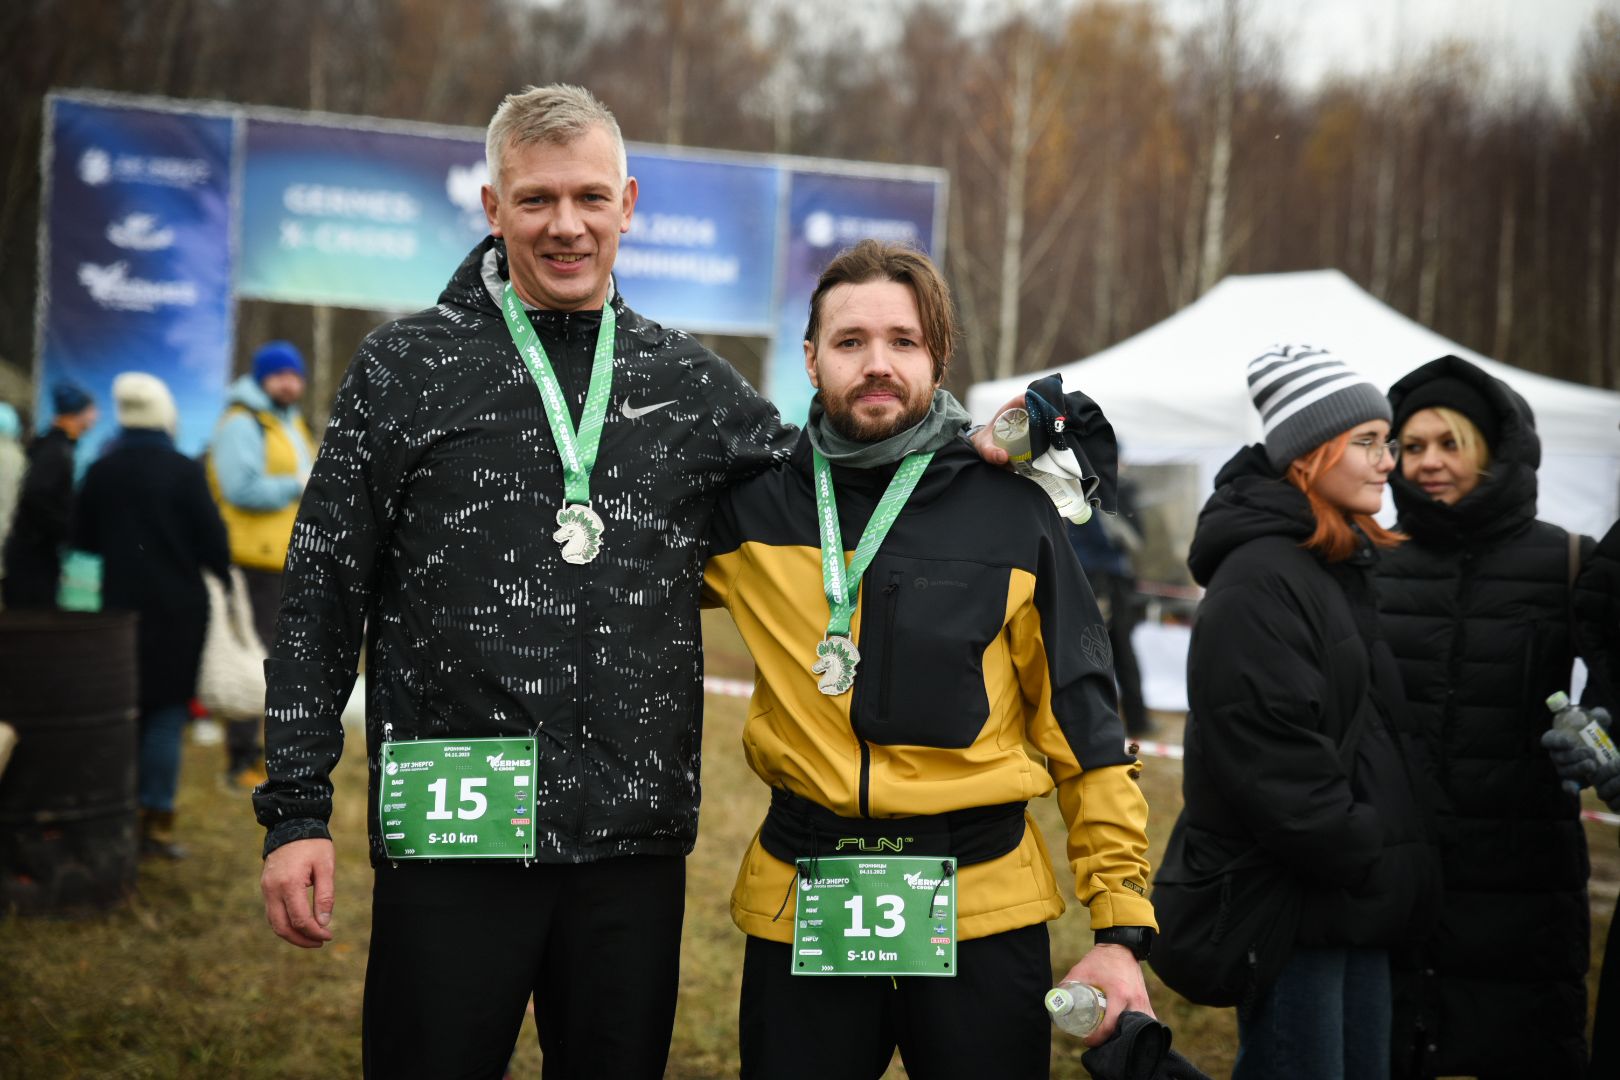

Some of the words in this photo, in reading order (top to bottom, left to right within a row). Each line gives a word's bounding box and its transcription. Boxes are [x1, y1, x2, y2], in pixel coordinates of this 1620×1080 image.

[426, 777, 488, 820] 15
[428, 832, 456, 844] S-10
[459, 832, 478, 843] km
[843, 894, 906, 938] 13
[847, 950, 876, 961] S-10
[879, 950, 898, 961] km
